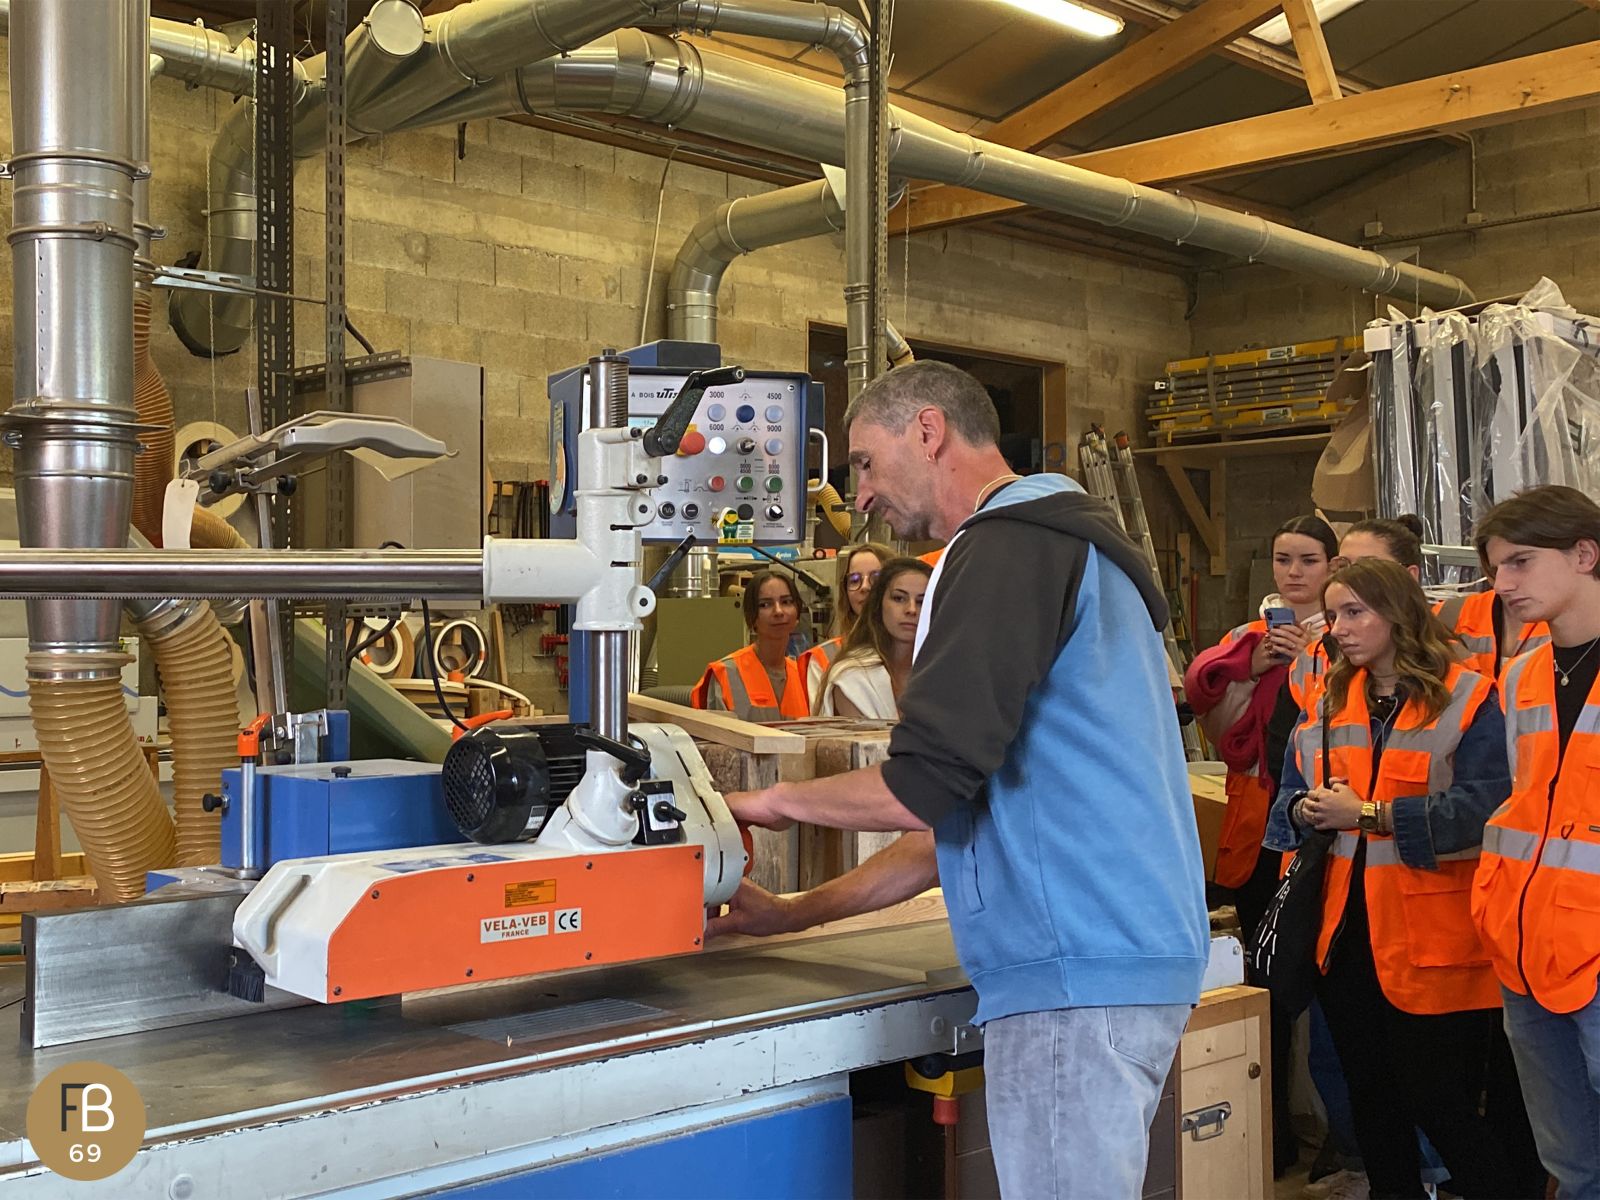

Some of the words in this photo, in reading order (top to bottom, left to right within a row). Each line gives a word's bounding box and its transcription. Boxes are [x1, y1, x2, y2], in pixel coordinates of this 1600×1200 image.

[709, 391, 725, 399] 3000
[767, 392, 782, 400] 4500
[484, 915, 547, 932] VELA-VEB
[558, 911, 578, 930] CE
[501, 928, 530, 939] FRANCE
